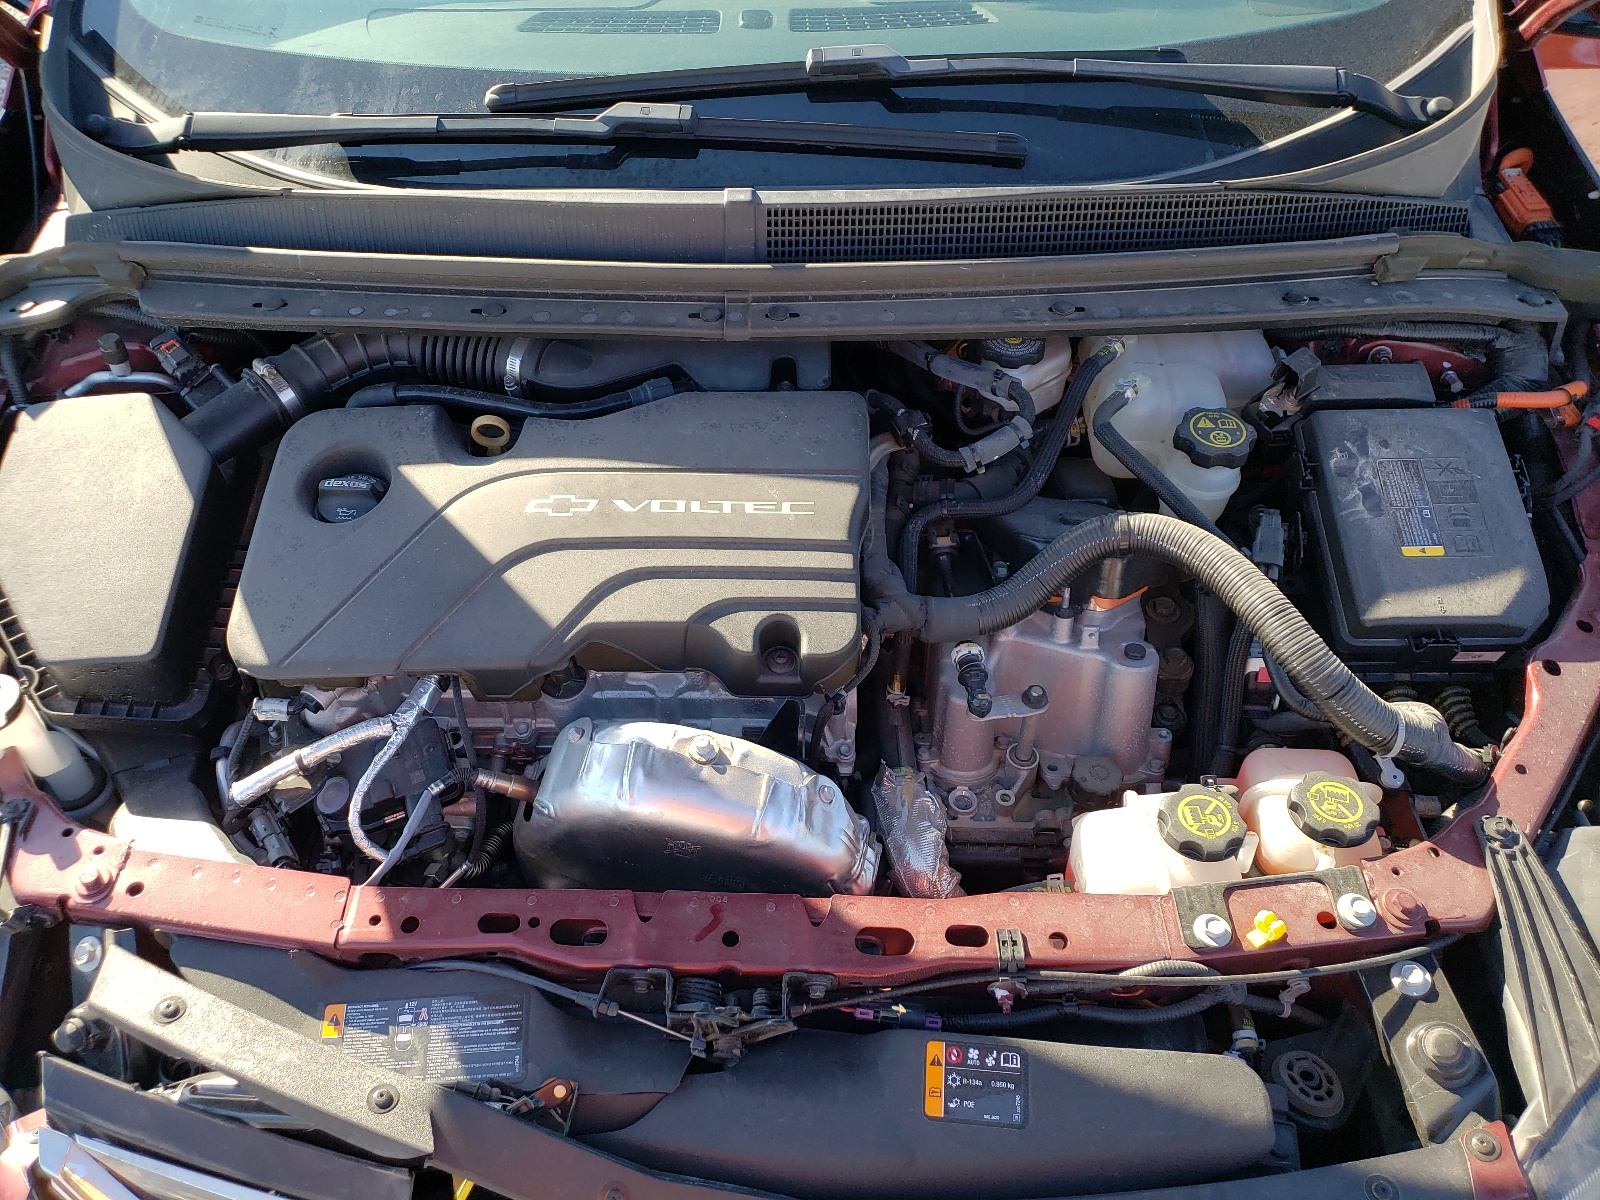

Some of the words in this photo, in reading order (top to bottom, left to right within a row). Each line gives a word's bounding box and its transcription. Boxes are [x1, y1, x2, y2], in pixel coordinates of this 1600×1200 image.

[324, 479, 370, 489] dexos
[611, 499, 815, 515] VOLTEC
[962, 1078, 983, 1087] R-134a
[1007, 1082, 1015, 1090] kg
[963, 1100, 975, 1109] POE
